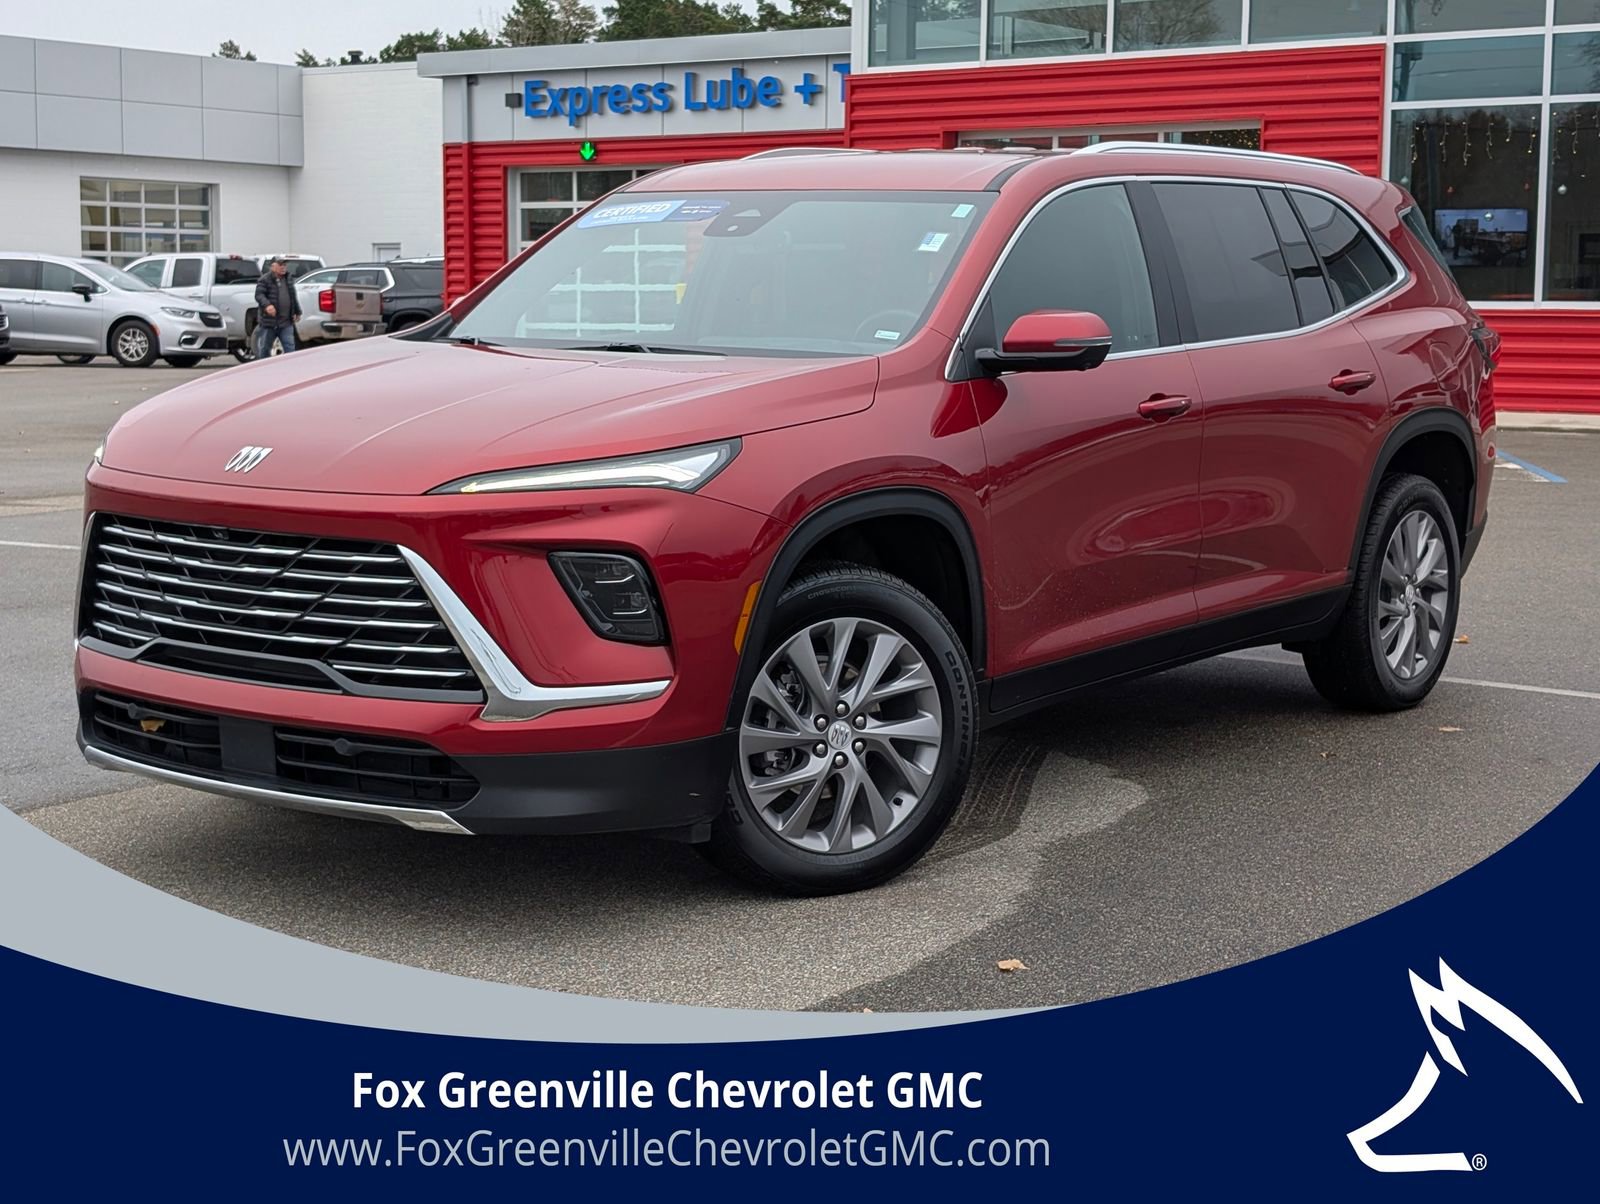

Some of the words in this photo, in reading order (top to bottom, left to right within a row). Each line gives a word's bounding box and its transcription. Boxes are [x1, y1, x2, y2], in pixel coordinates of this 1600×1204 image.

[524, 79, 671, 127] Express
[684, 67, 781, 111] Lube
[593, 203, 671, 219] CERTIFIED
